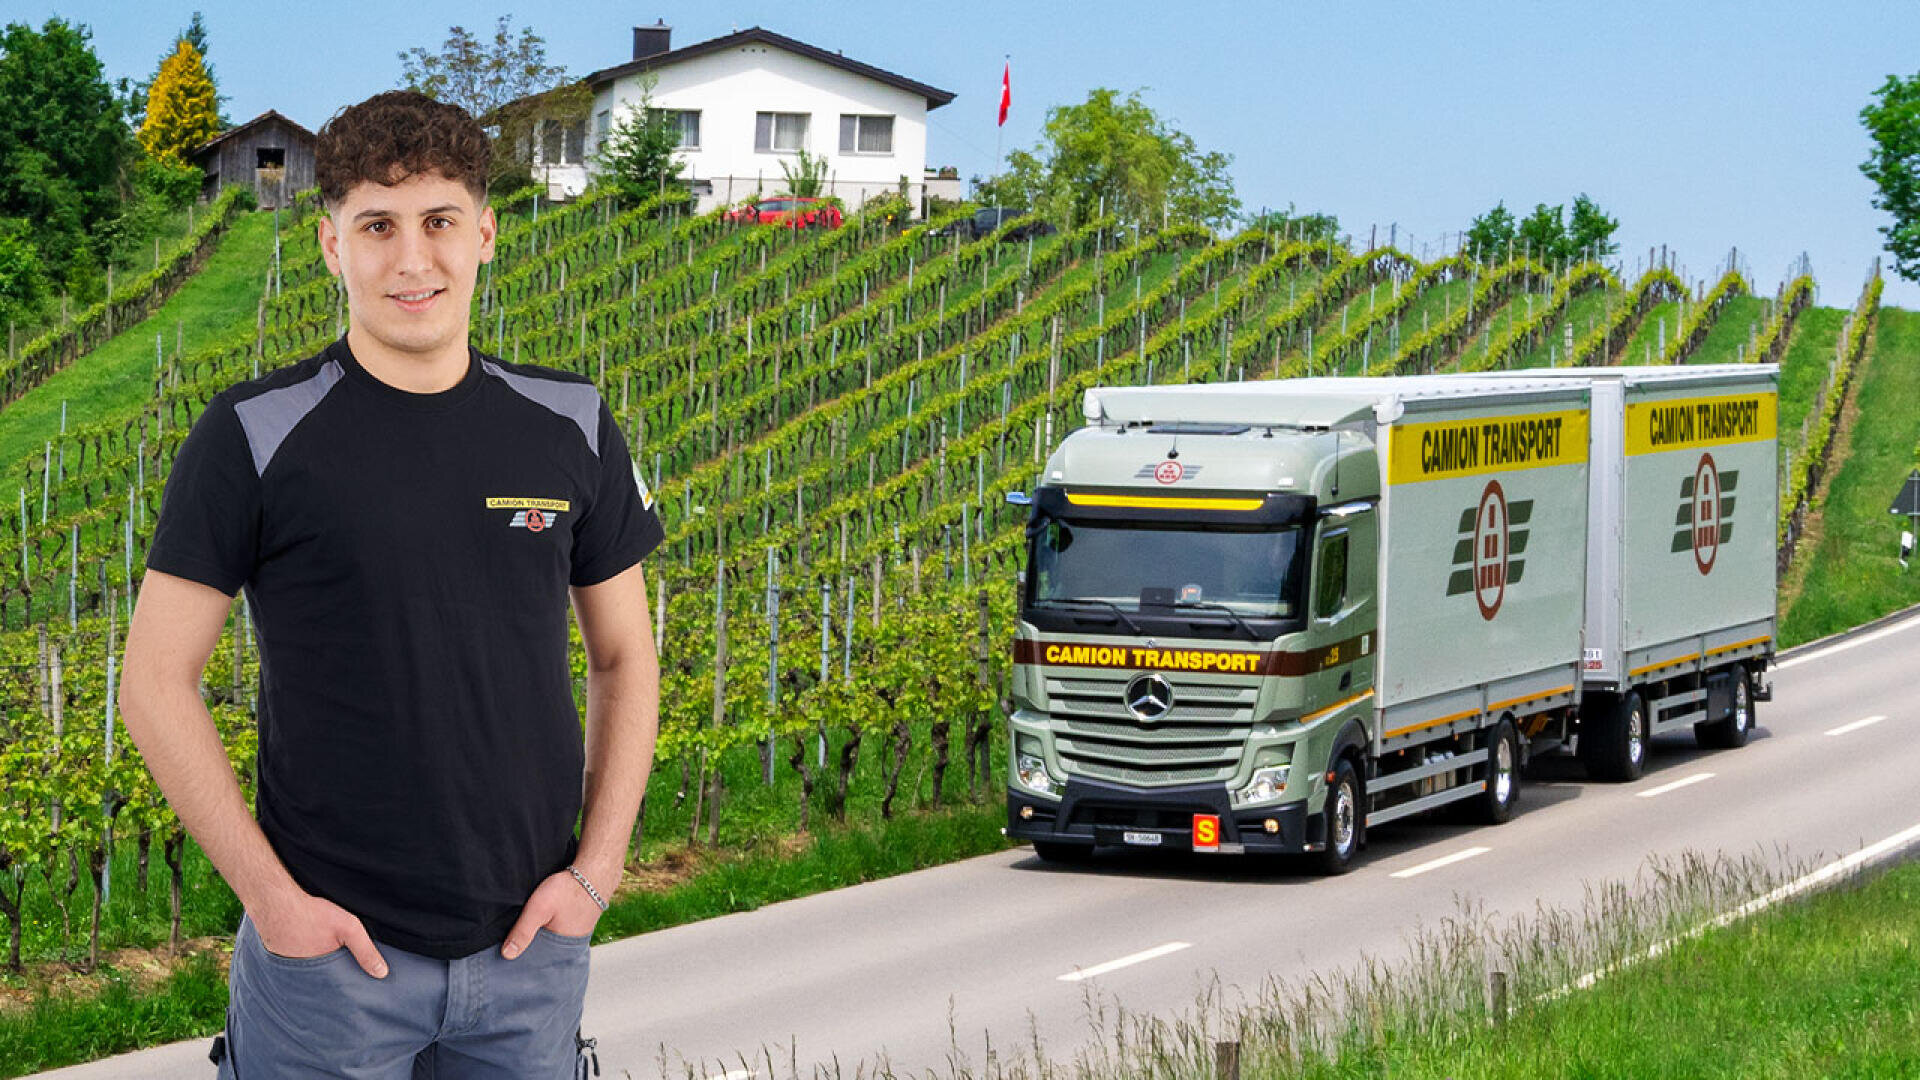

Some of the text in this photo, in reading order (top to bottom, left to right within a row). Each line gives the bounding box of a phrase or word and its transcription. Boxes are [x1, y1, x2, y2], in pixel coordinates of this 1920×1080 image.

[1650, 399, 1759, 446] CAMION TRANSPORT
[1421, 416, 1562, 474] CAMION TRANSPORT
[490, 499, 567, 509] CAMION TRANSPORT
[1046, 645, 1261, 672] CAMION TRANSPORT
[1197, 820, 1215, 843] S
